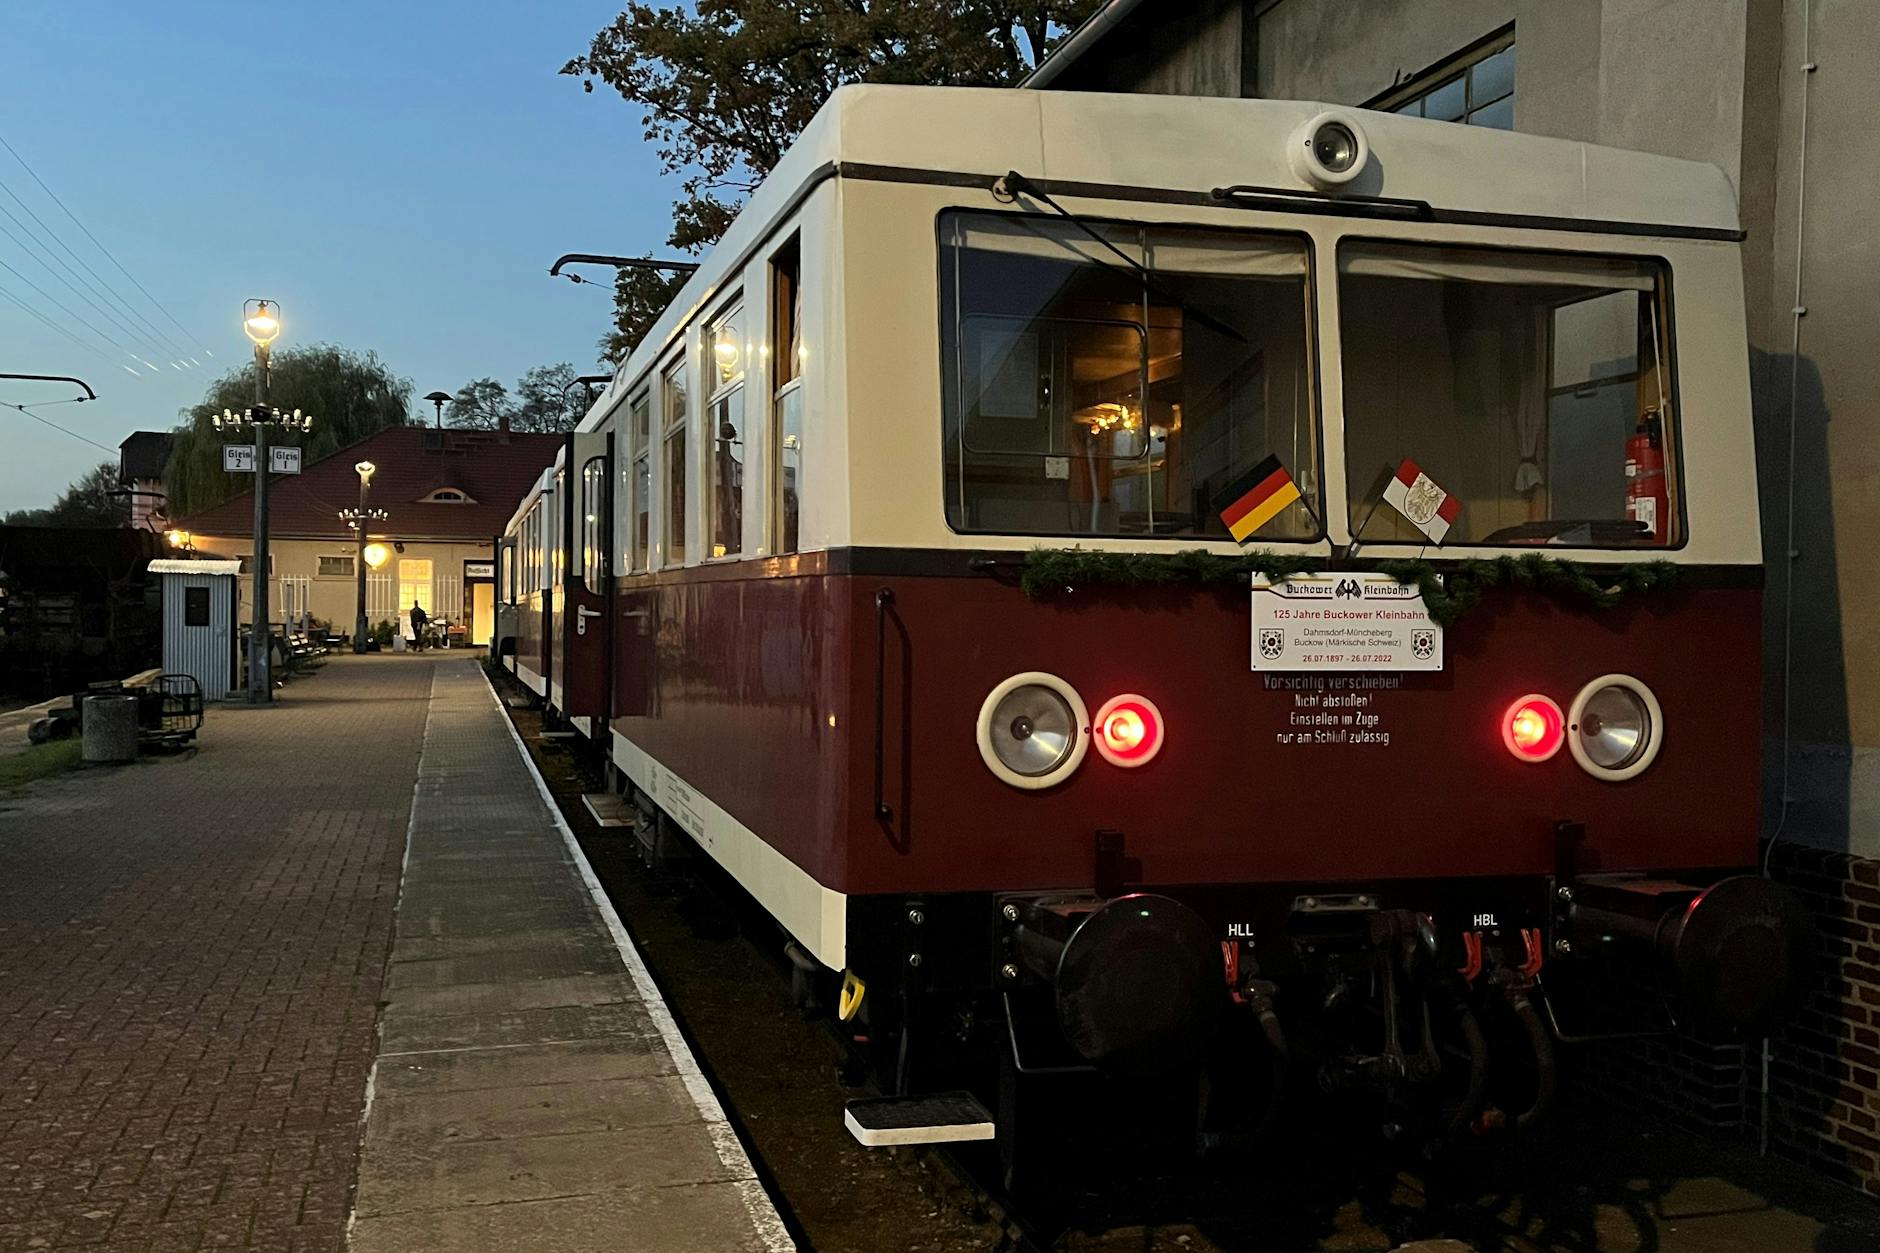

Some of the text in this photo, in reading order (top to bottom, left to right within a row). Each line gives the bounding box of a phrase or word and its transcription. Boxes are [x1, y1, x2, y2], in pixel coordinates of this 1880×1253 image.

[228, 449, 251, 459] Gleis
[276, 451, 298, 461] Gleis
[235, 459, 241, 467] 2
[283, 460, 287, 469] 1
[1286, 584, 1409, 596] Buckower Kleinbahn
[1273, 610, 1425, 620] 125 Jahre Buckower Kleinbahn
[1303, 628, 1393, 638] Dahmsdorf-Müncheberg
[1294, 638, 1402, 648] Buckow (Märkische Schweiz)
[1302, 655, 1344, 663] 26.07.1897
[1351, 655, 1393, 663] 26.07.2022
[1264, 674, 1325, 692] Vorsichtig
[1295, 694, 1319, 707] Nicht
[1290, 711, 1379, 728] Einstellen im Zuge
[1276, 732, 1294, 743] nur
[1297, 733, 1312, 743] am
[1315, 729, 1346, 743] Schluß
[1473, 914, 1498, 927] HBL
[1228, 923, 1254, 937] HLL
